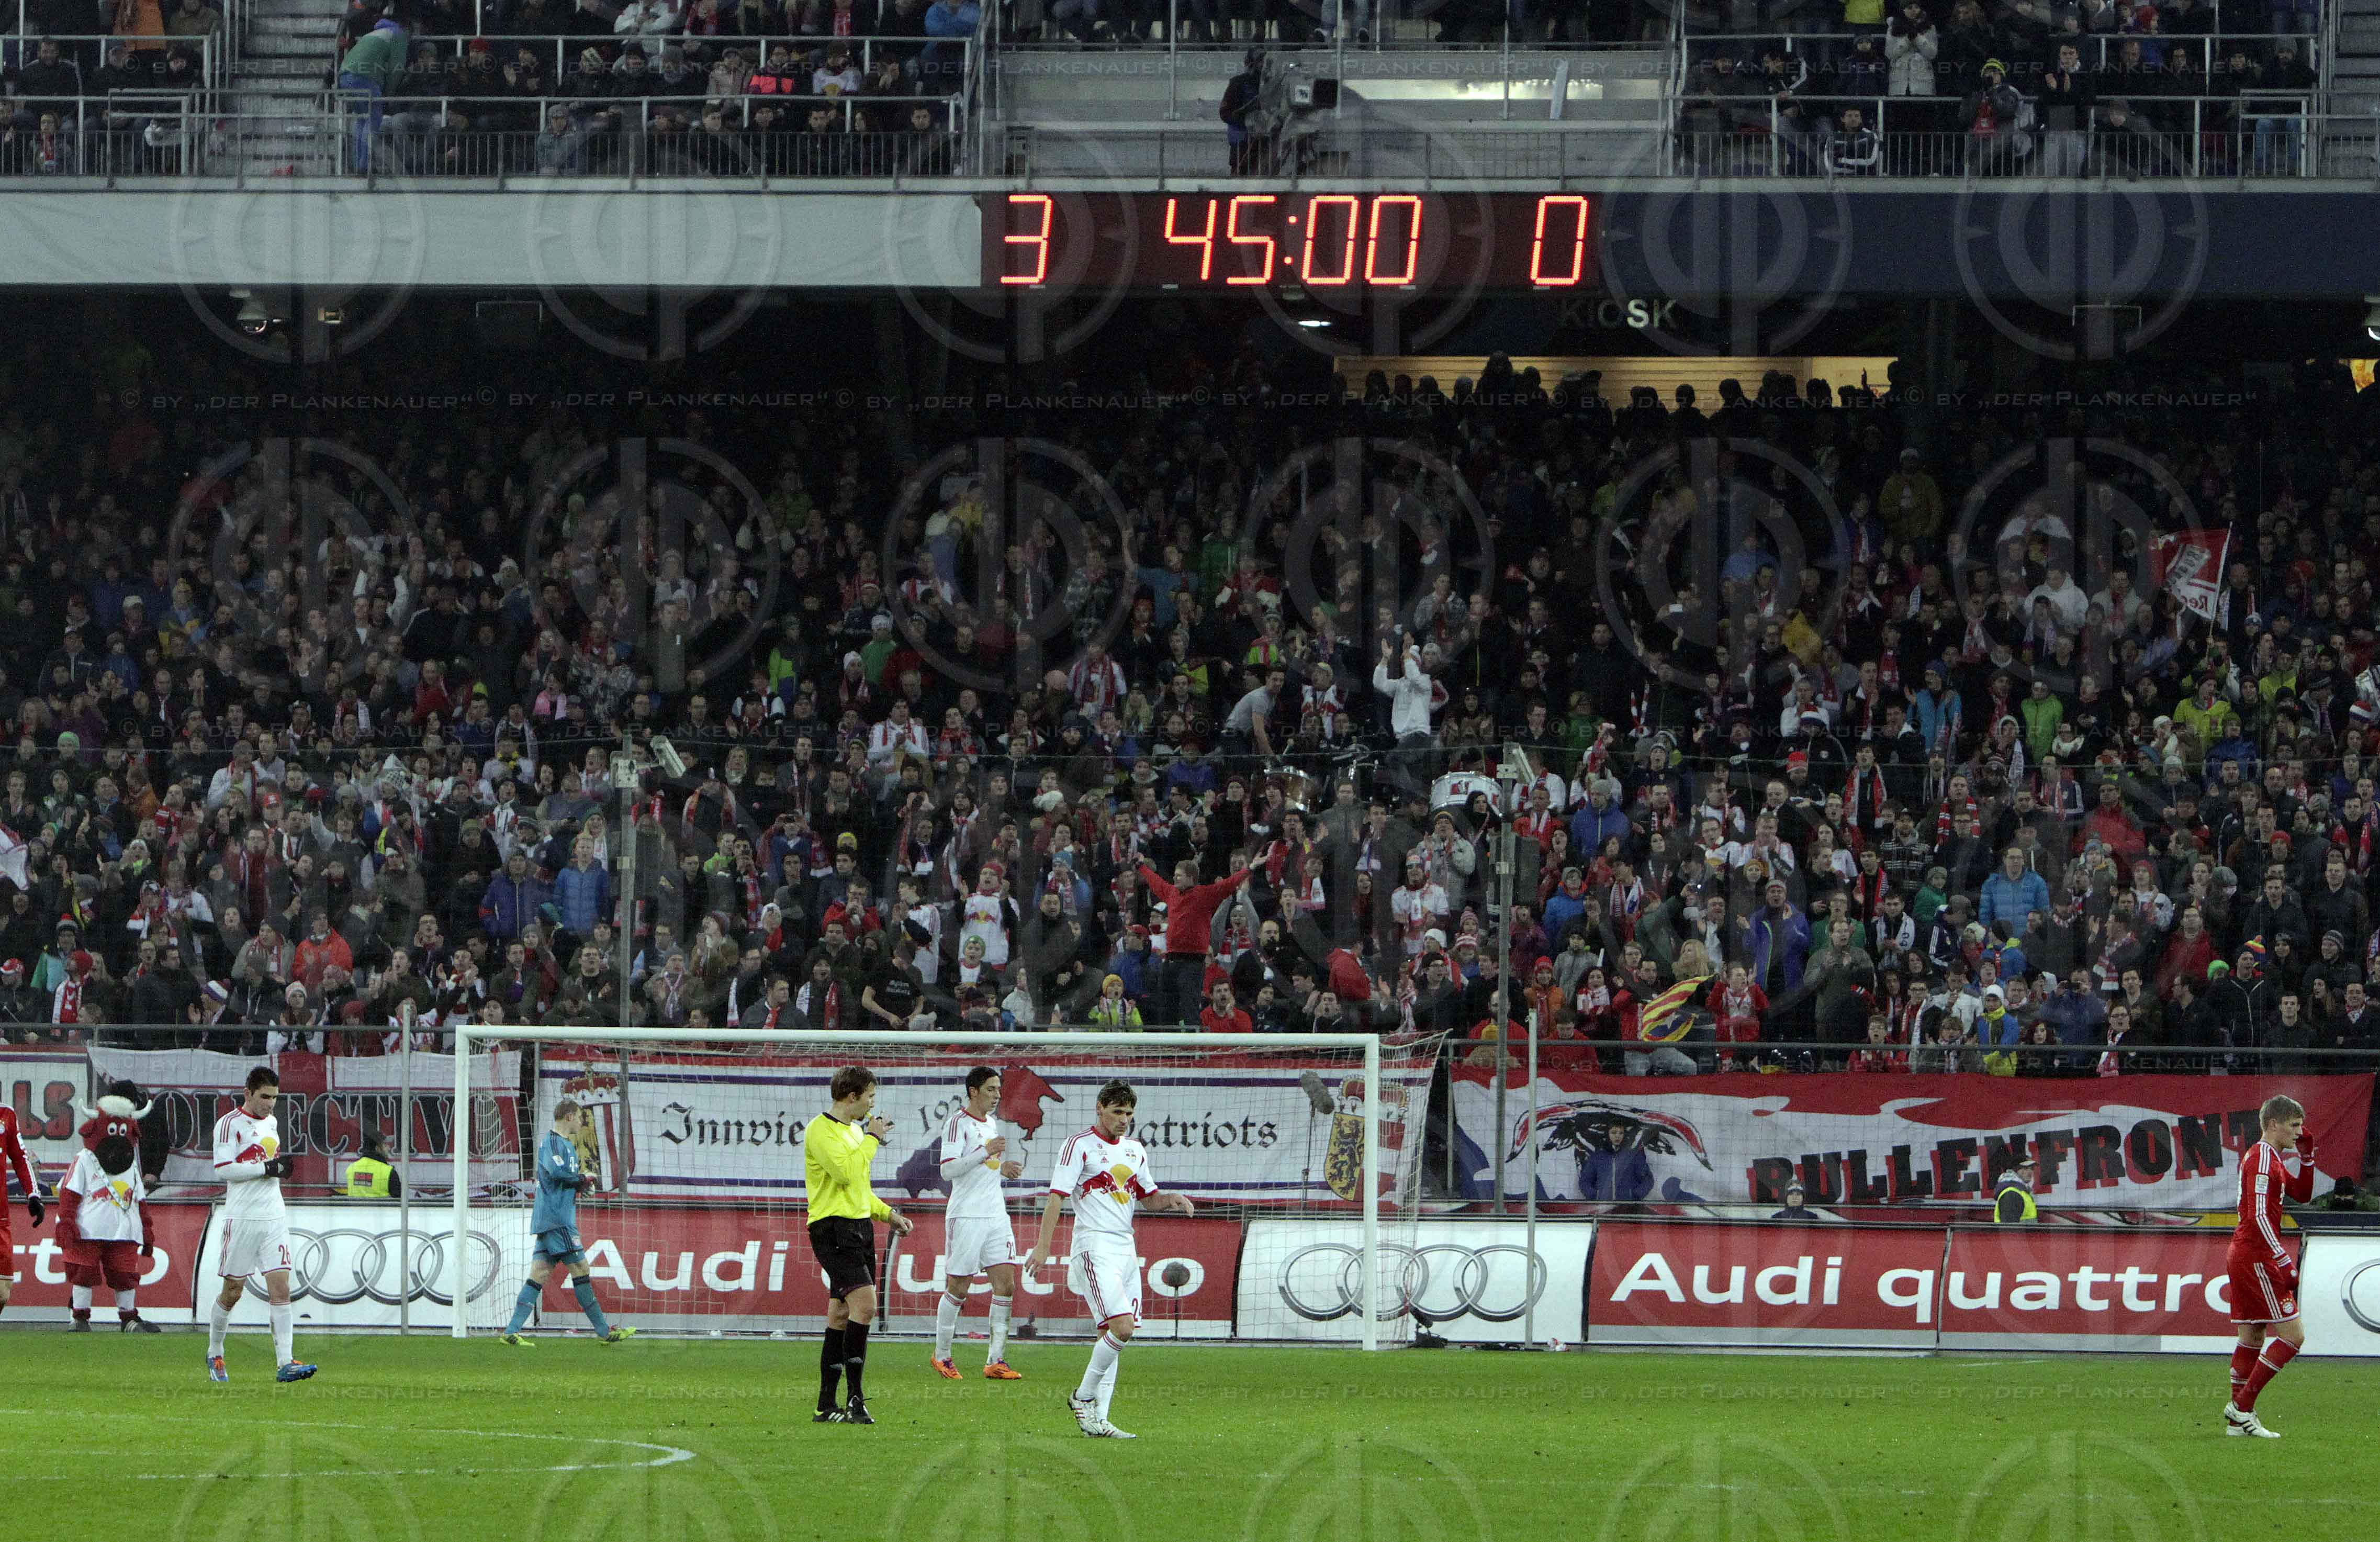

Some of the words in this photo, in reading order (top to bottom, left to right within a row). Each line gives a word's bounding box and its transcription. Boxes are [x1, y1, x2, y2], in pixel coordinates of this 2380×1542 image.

[1000, 194, 1053, 285] 3
[1163, 194, 1423, 286] 45:00
[1530, 195, 1589, 286] 0
[1560, 298, 1677, 329] KIOSK
[138, 1090, 501, 1156] OLECTIVO
[562, 1239, 789, 1293] Audi
[1610, 1253, 1843, 1305] Audi
